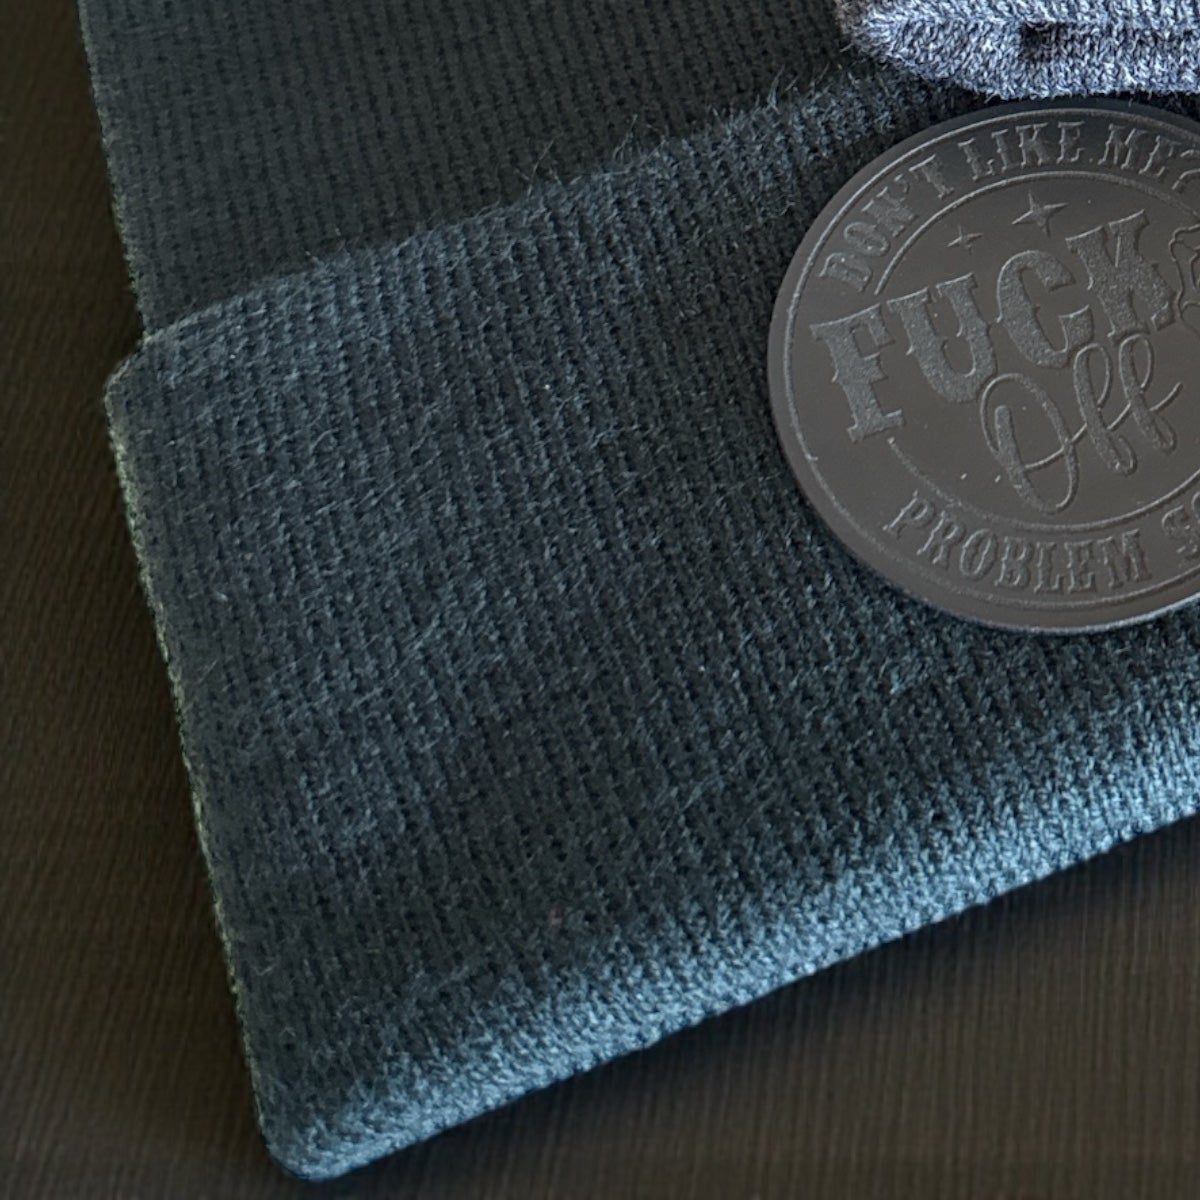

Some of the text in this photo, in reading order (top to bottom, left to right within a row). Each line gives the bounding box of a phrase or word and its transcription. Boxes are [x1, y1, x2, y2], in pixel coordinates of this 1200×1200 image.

[820, 154, 955, 293] DON'T
[958, 121, 1086, 181] LIKE
[809, 209, 1178, 443] FUCK
[980, 333, 1184, 514] Off
[882, 490, 1154, 593] PROBLEM
